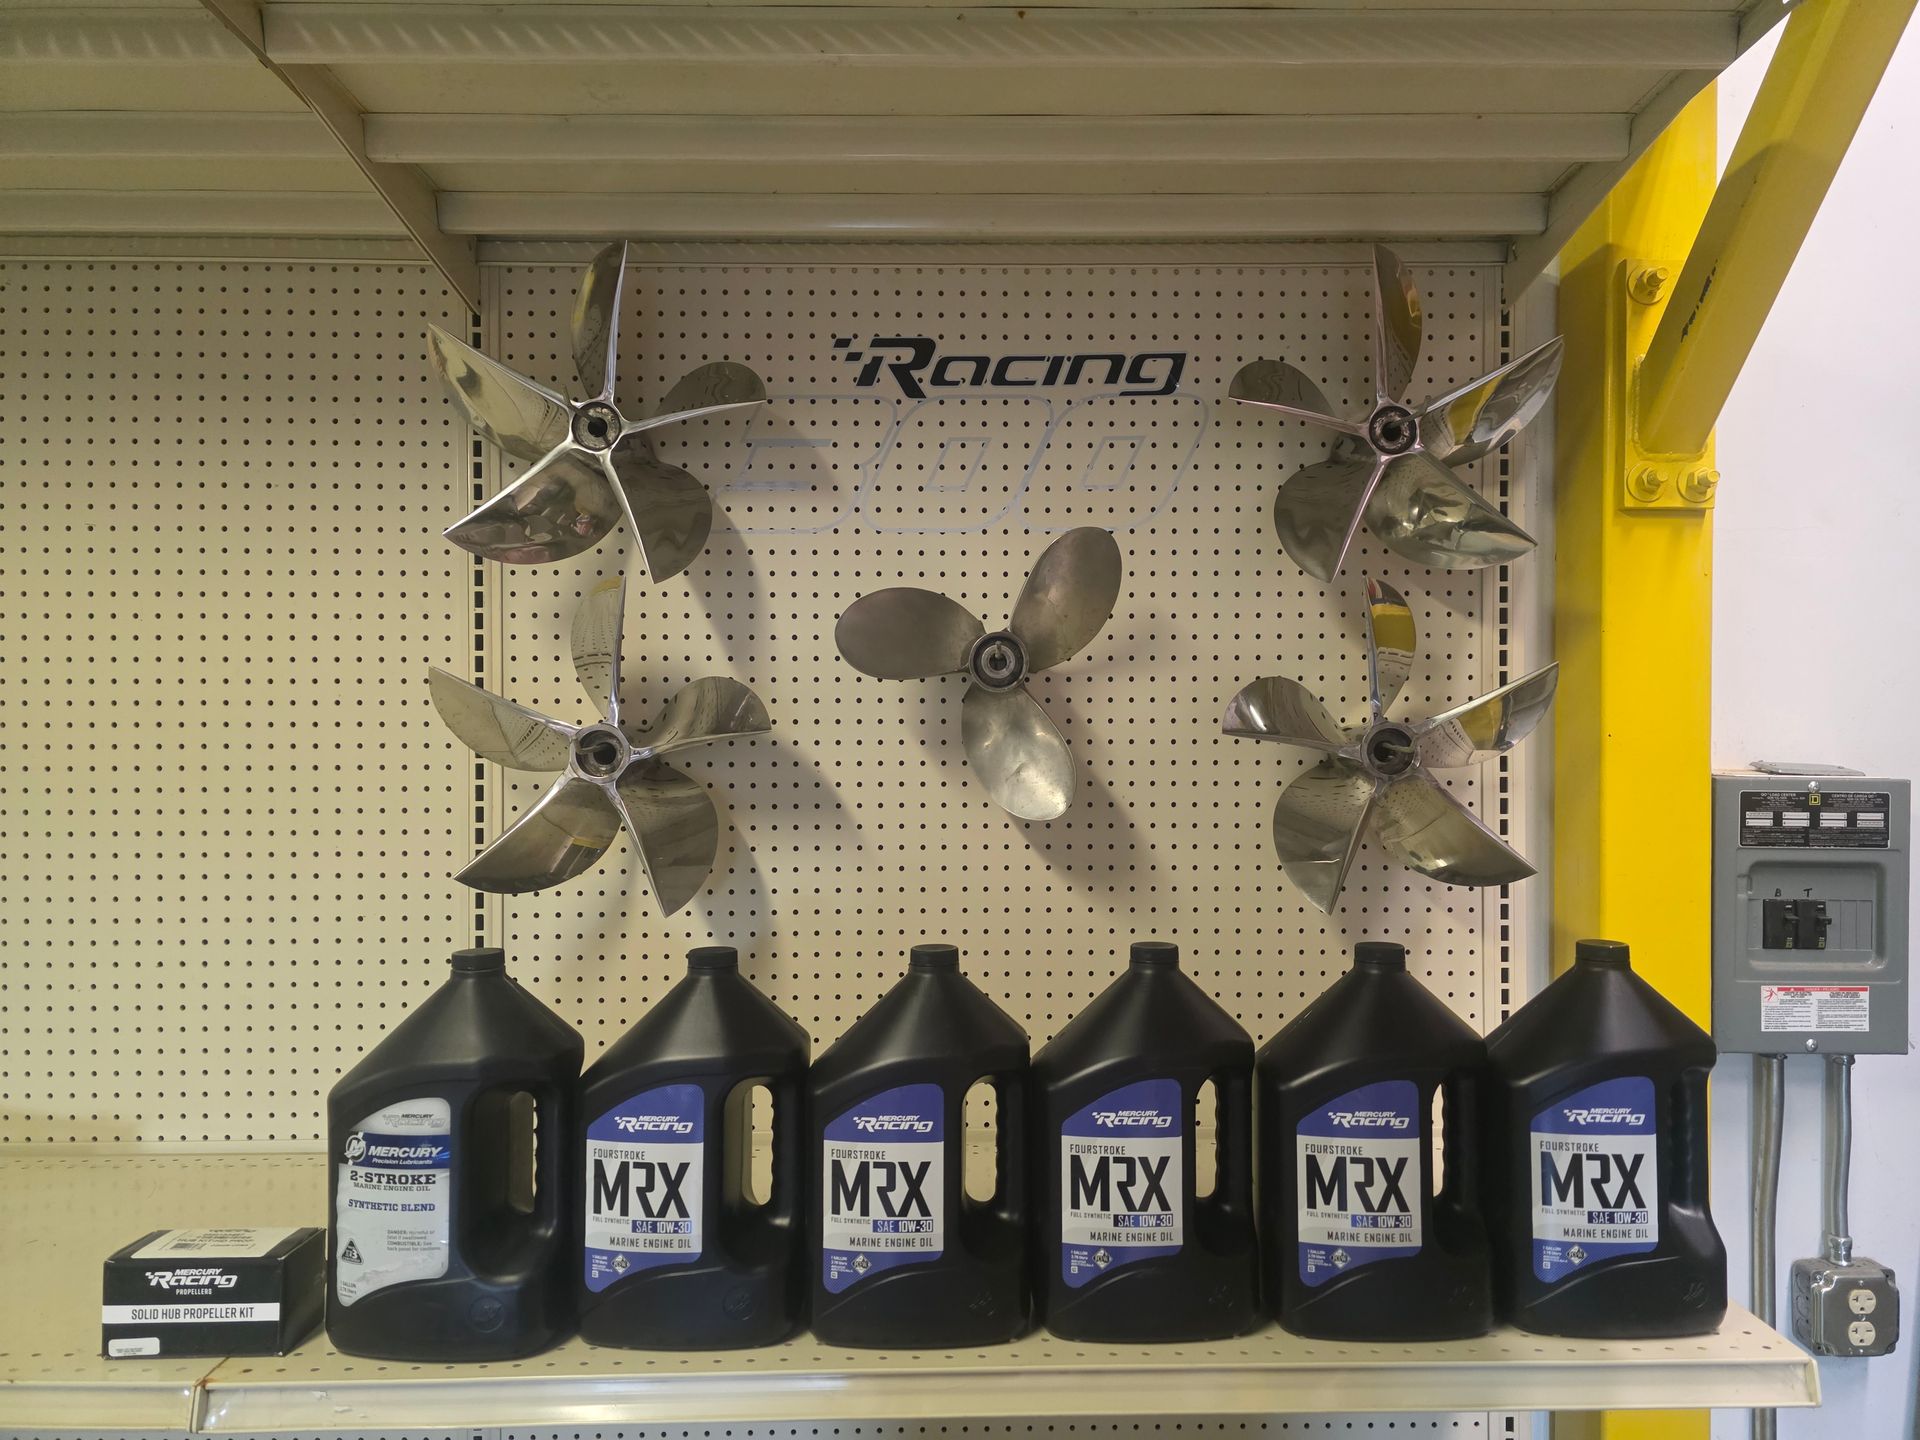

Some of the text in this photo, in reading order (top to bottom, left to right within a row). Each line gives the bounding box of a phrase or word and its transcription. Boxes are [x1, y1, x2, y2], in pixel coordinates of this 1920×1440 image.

[856, 337, 1187, 399] Racing
[1803, 888, 1813, 897] T
[1096, 1111, 1172, 1128] Racing
[1332, 1112, 1410, 1129] Racing
[1568, 1109, 1646, 1126] Racing
[618, 1116, 693, 1133] Racing
[857, 1116, 934, 1133] Racing
[368, 1145, 444, 1158] MERCURY
[1070, 1144, 1126, 1155] FOURSTROKE
[1305, 1144, 1363, 1155] FOURSTROKE
[1540, 1140, 1599, 1153] FOURSTROKE
[593, 1148, 646, 1160] FOURSTROKE
[831, 1148, 886, 1160] FOURSTROKE
[350, 1170, 436, 1185] 2-STROKE
[1070, 1155, 1172, 1212] MRX
[1306, 1154, 1410, 1213] MRX
[1540, 1151, 1646, 1210] MRX
[353, 1182, 382, 1191] MARINE
[384, 1184, 414, 1192] ENGINE
[593, 1159, 691, 1218] MRX
[831, 1159, 932, 1218] MRX
[348, 1199, 436, 1212] SYNTHETIC BLEND
[1070, 1211, 1111, 1220] FULL SYNTHETIC
[1307, 1211, 1349, 1220] FULL SYNTHETIC
[1541, 1208, 1555, 1216] FULL
[1592, 1211, 1648, 1224] SAE 10W-30
[592, 1216, 630, 1225] FULL SYNTHETIC
[831, 1216, 871, 1225] FULL SYNTHETIC
[1117, 1215, 1173, 1227] SAE 10W-30
[1356, 1215, 1411, 1228] SAE 10W-30
[636, 1221, 691, 1233] SAE 10W-30
[877, 1221, 933, 1233] SAE 10W-30
[1563, 1227, 1649, 1239] MARINE ENGINE OIL
[609, 1236, 692, 1248] MARINE ENGINE OIL
[849, 1236, 933, 1248] MARINE ENGINE OIL
[1090, 1231, 1174, 1242] MARINE ENGINE OIL
[1327, 1231, 1412, 1242] MARINE ENGINE OIL
[150, 1272, 238, 1289] Racing
[131, 1307, 254, 1320] SOLID HUB PROPELLER KIT
